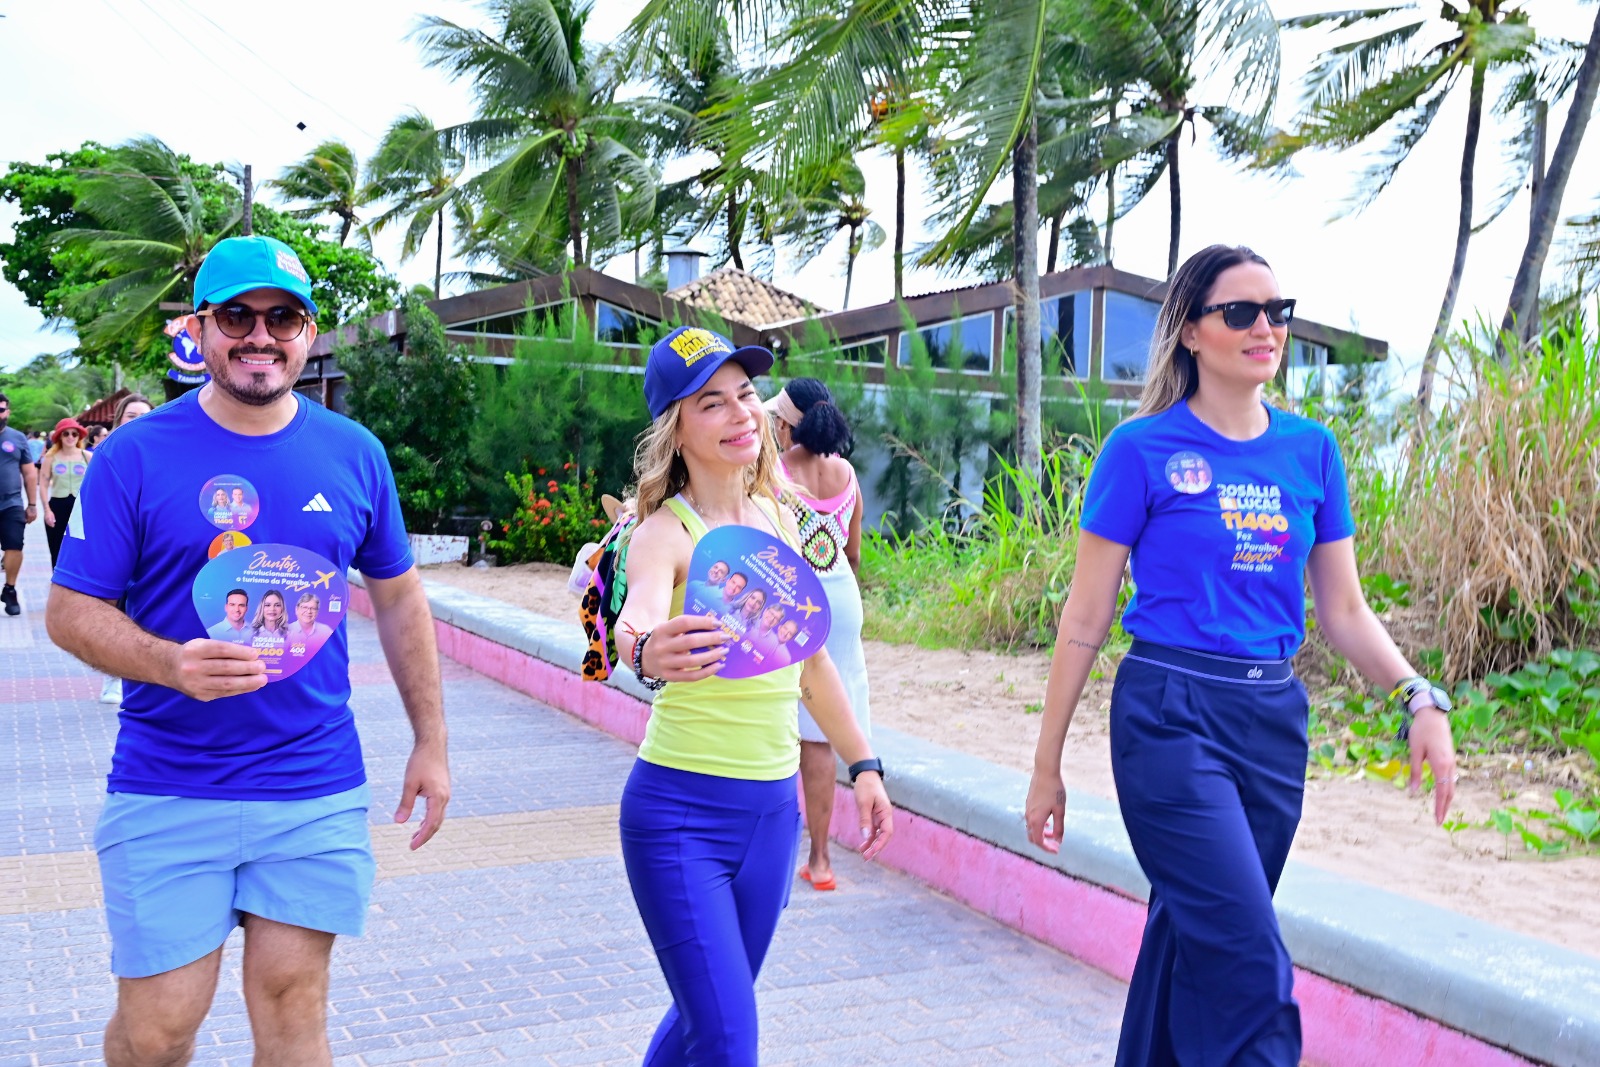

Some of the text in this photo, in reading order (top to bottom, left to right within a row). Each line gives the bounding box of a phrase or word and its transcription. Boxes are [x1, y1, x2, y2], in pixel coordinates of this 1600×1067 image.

[1236, 497, 1281, 510] LUCAS
[1221, 511, 1289, 532] 11400
[1236, 531, 1252, 541] Fez
[1235, 543, 1242, 551] a
[248, 551, 300, 573] Juntos,
[757, 546, 798, 587] Juntos,
[1231, 561, 1273, 573] mais alto
[243, 569, 299, 579] revolucionamos
[745, 559, 767, 582] turismo
[765, 577, 773, 585] da
[749, 553, 792, 592] revolucionamos
[242, 576, 270, 585] turismo
[271, 577, 280, 585] da
[290, 646, 306, 654] 400
[1247, 665, 1263, 678] alo
